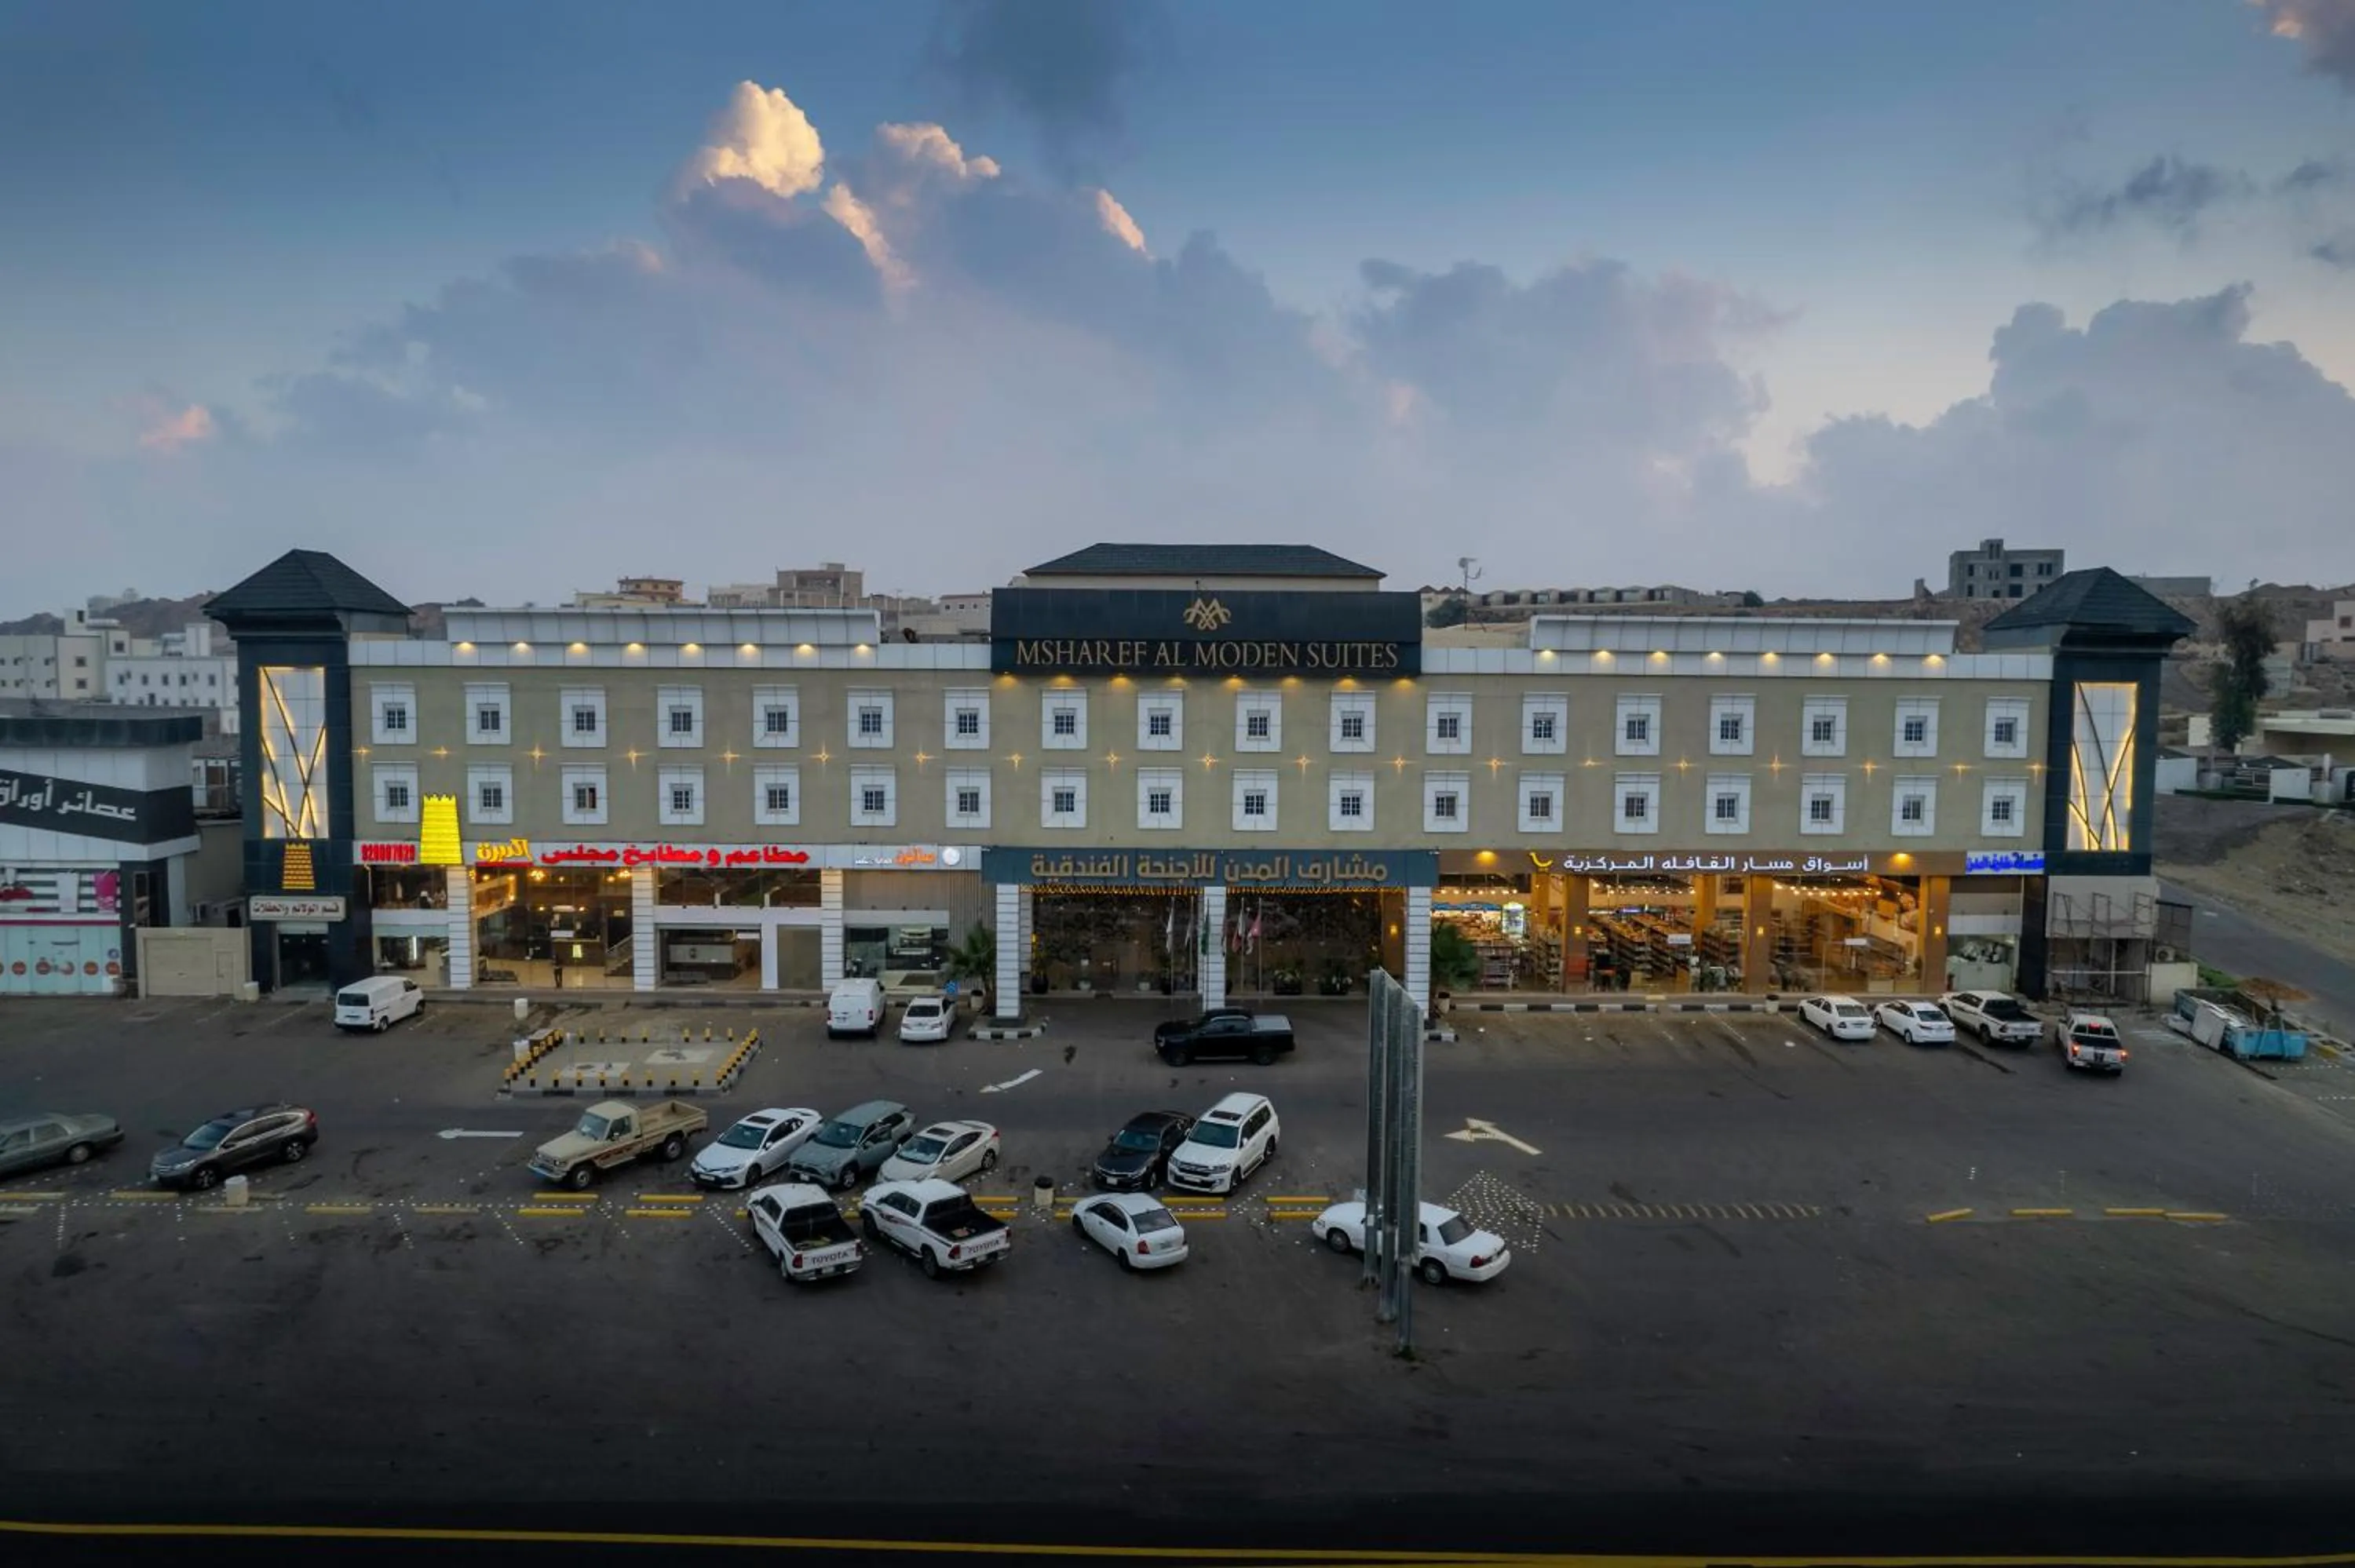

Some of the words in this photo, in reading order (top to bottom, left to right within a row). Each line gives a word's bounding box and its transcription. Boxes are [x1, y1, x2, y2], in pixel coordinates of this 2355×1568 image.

[1016, 639, 1148, 667] MSHAREF
[1154, 641, 1188, 667] AL
[1194, 640, 1301, 669] MODEN
[1306, 642, 1399, 669] SUITES
[57, 789, 137, 822] عصائر
[541, 844, 620, 865] مجلس
[622, 844, 704, 866] مطابخ
[725, 845, 810, 868] مطاعم
[1563, 855, 1655, 872] المركزية
[1742, 856, 1794, 873] مسار
[1802, 853, 1869, 873] أسواق
[1031, 853, 1129, 884] الفندقية
[1224, 855, 1291, 882] المدن
[1297, 852, 1388, 884] مشارف
[812, 1251, 848, 1265] TOYOTA
